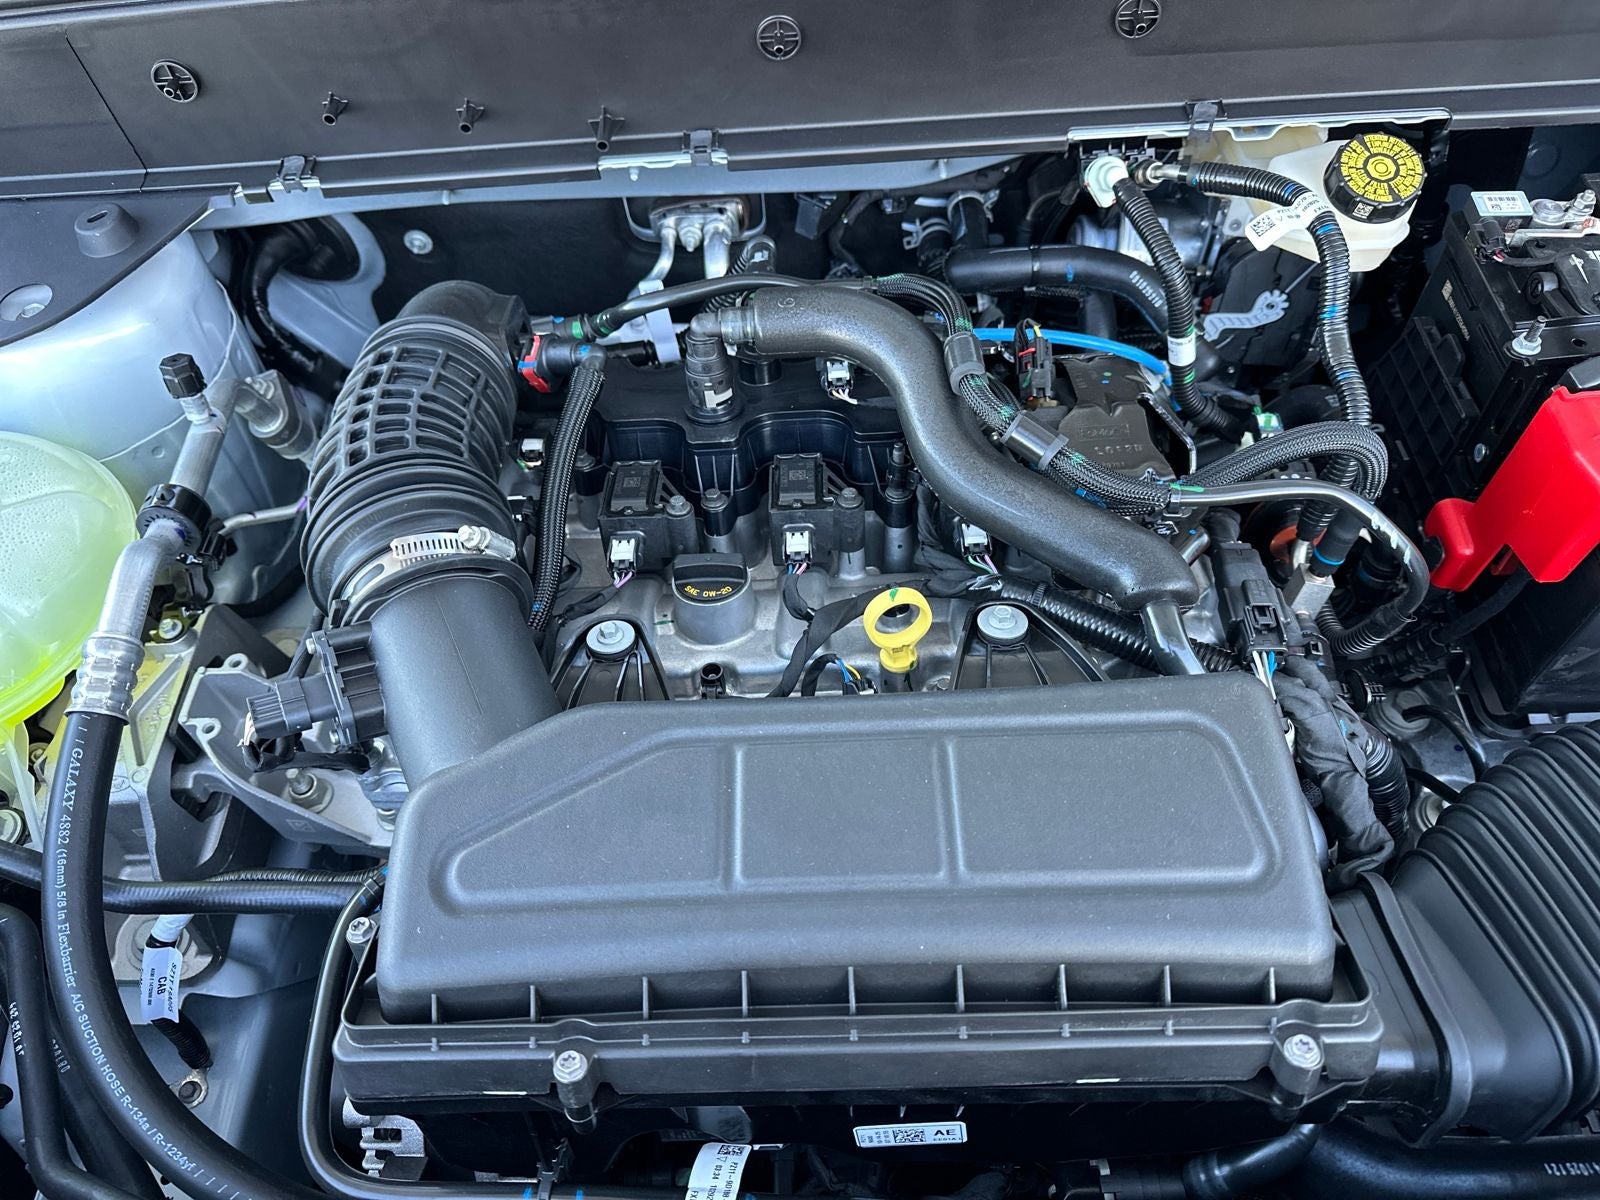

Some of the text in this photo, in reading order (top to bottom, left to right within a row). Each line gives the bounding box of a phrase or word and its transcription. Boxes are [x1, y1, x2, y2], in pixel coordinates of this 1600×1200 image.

[684, 586, 732, 597] SAE 0W-20
[62, 748, 84, 812] GALAXY
[58, 814, 72, 845] 4882
[55, 848, 68, 888] (16mm)
[56, 892, 67, 908] 5/8
[58, 922, 78, 988] Flexbarrier
[70, 993, 86, 1013] A/C
[156, 976, 168, 995] CAB
[78, 1014, 107, 1065] SUCTION
[100, 1063, 126, 1097] HOSE
[120, 1094, 150, 1132] R-134a
[152, 1132, 197, 1173] R-1234yf
